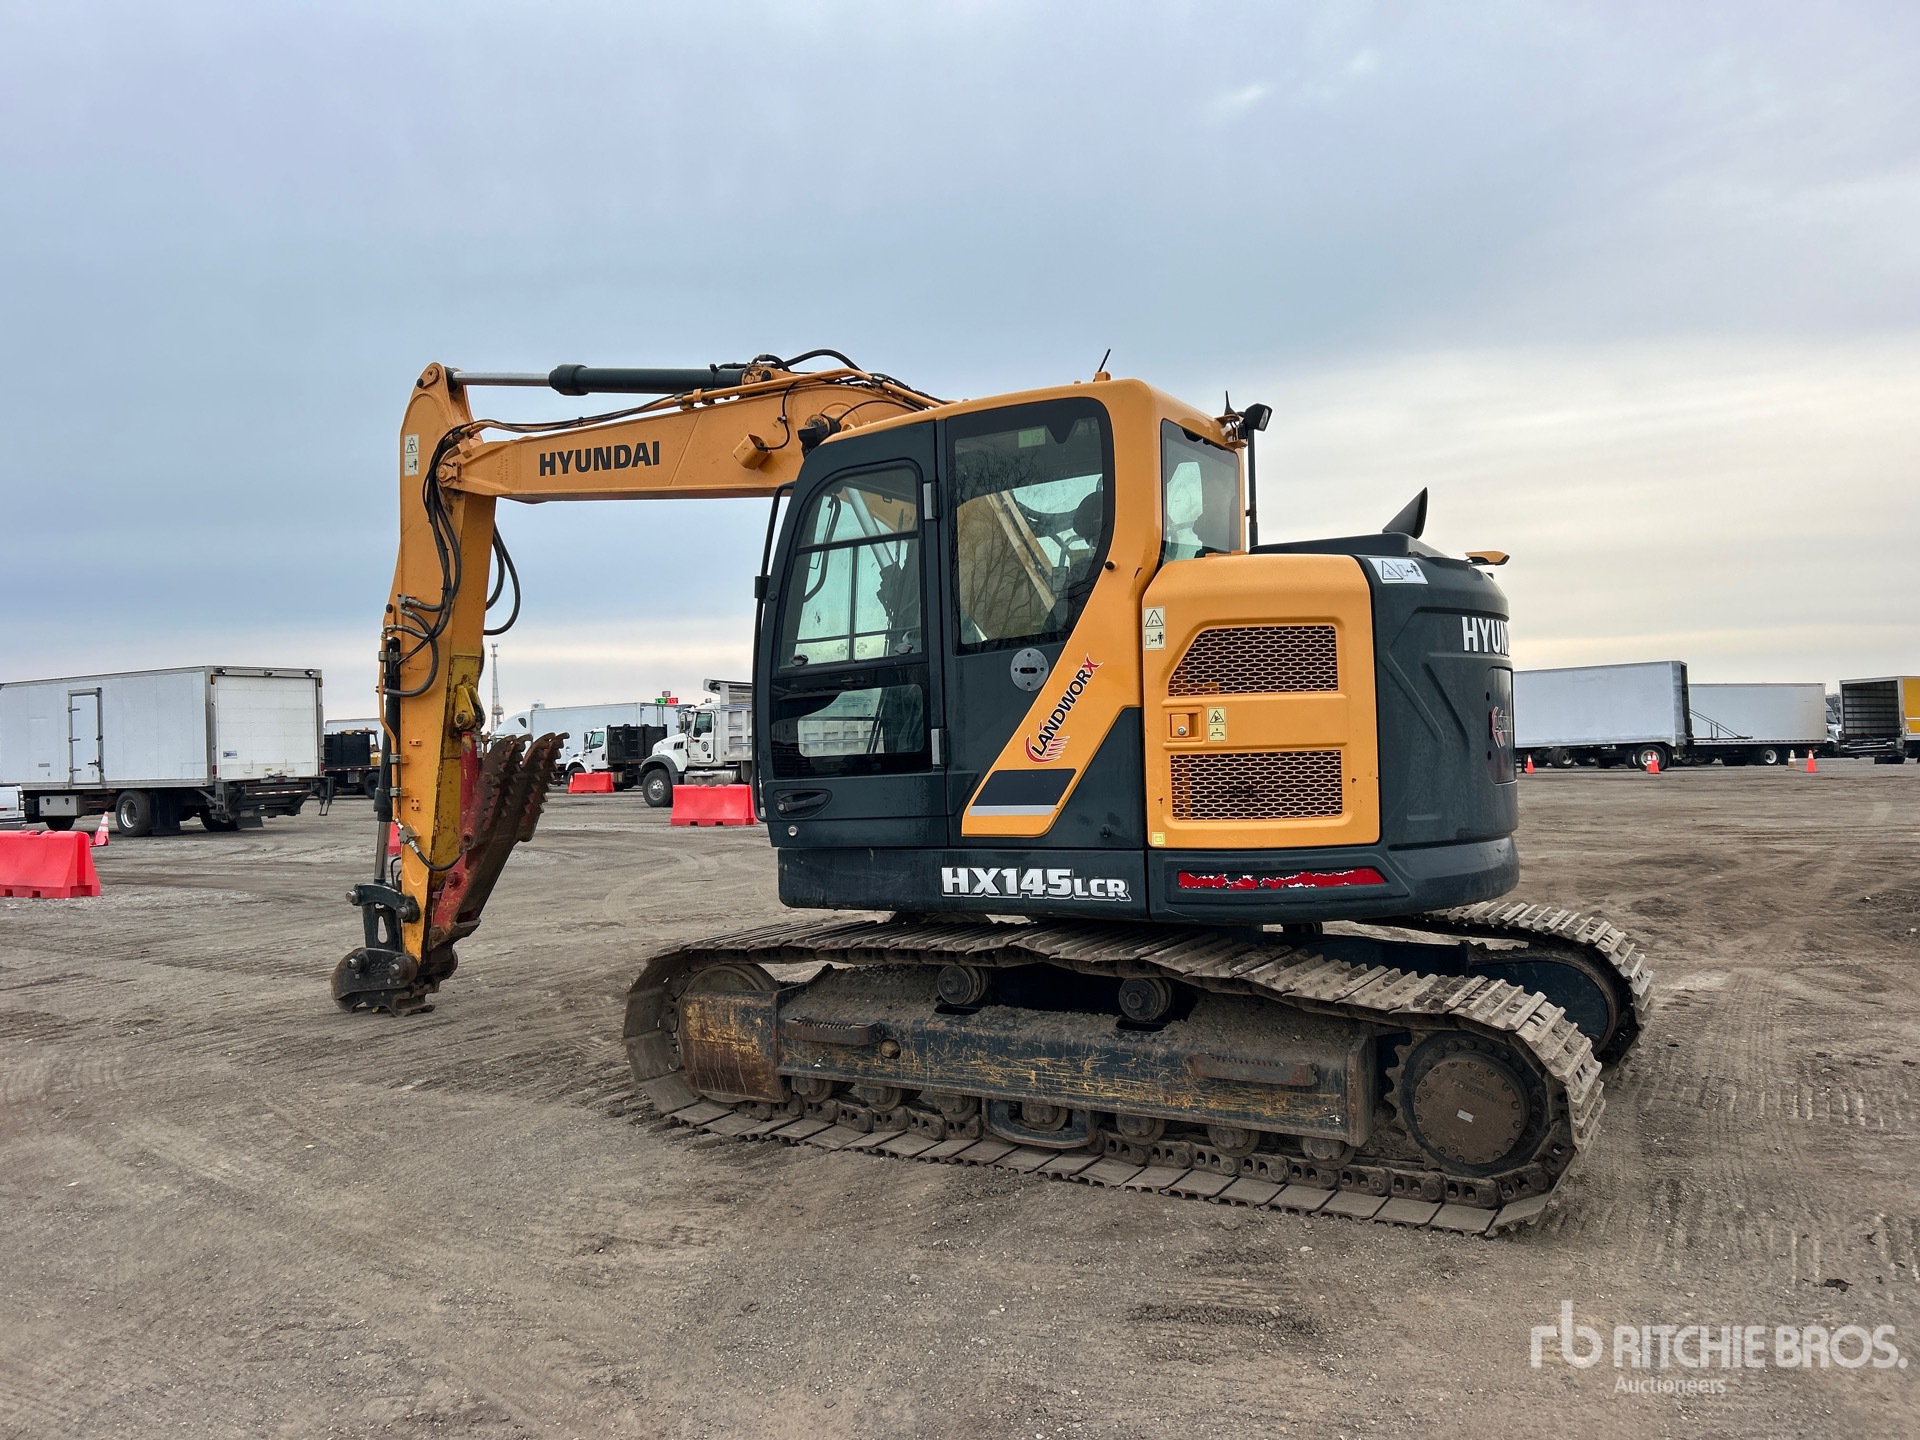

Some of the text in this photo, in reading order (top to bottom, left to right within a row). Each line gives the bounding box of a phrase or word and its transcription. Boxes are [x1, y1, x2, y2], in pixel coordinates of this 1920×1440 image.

[540, 441, 660, 476] HYUNDAI
[1031, 654, 1102, 757] LANDWORX
[941, 867, 1130, 900] HX145LCR
